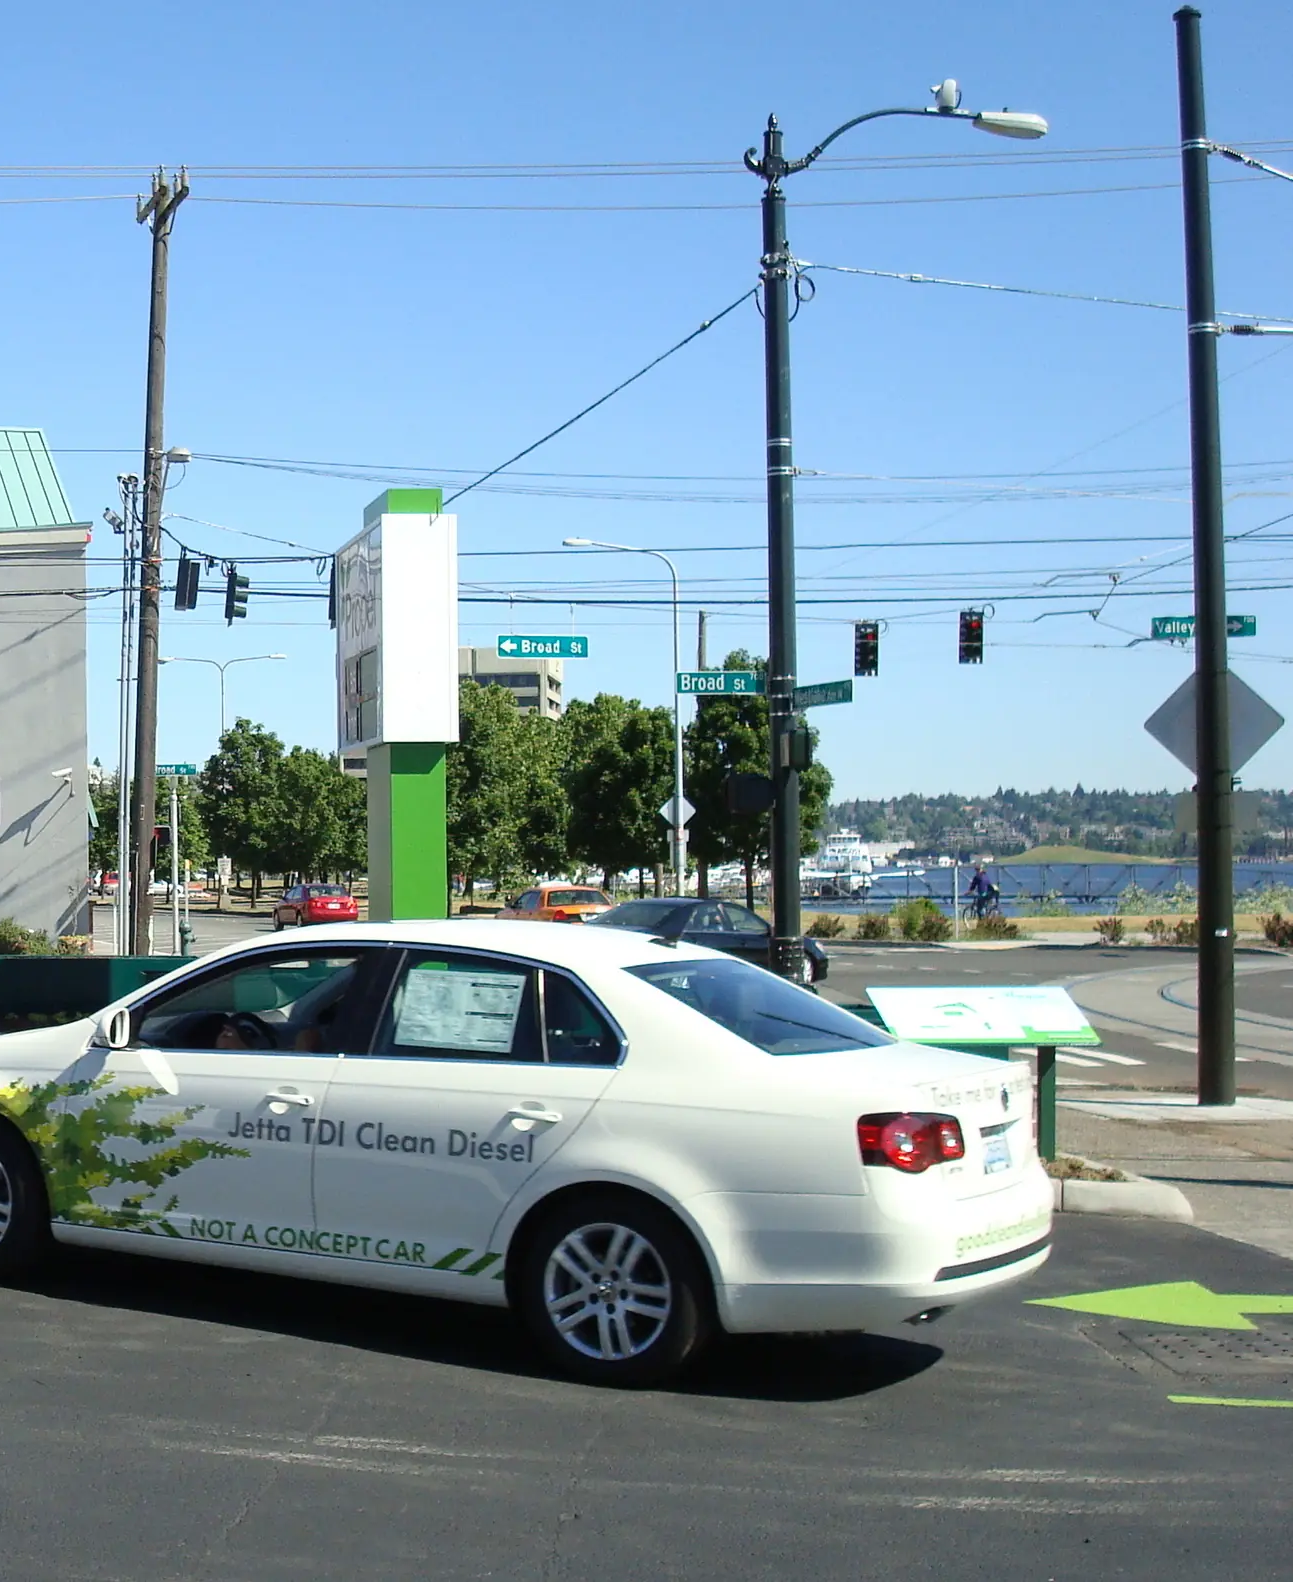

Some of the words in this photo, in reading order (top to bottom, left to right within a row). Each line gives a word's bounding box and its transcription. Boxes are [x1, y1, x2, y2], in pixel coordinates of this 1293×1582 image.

[1155, 621, 1196, 637] Valley
[521, 639, 561, 654] Broad
[570, 641, 582, 654] St
[680, 673, 725, 691] Broad
[733, 678, 746, 691] St
[156, 765, 176, 775] road
[228, 1111, 291, 1143] Jetta
[301, 1117, 345, 1147] TDI
[356, 1121, 435, 1155] Clean
[448, 1128, 534, 1163] Diesel
[190, 1218, 237, 1241] NOT
[241, 1223, 258, 1244] A
[264, 1226, 372, 1258] CONCEPT
[374, 1238, 426, 1264] CAR
